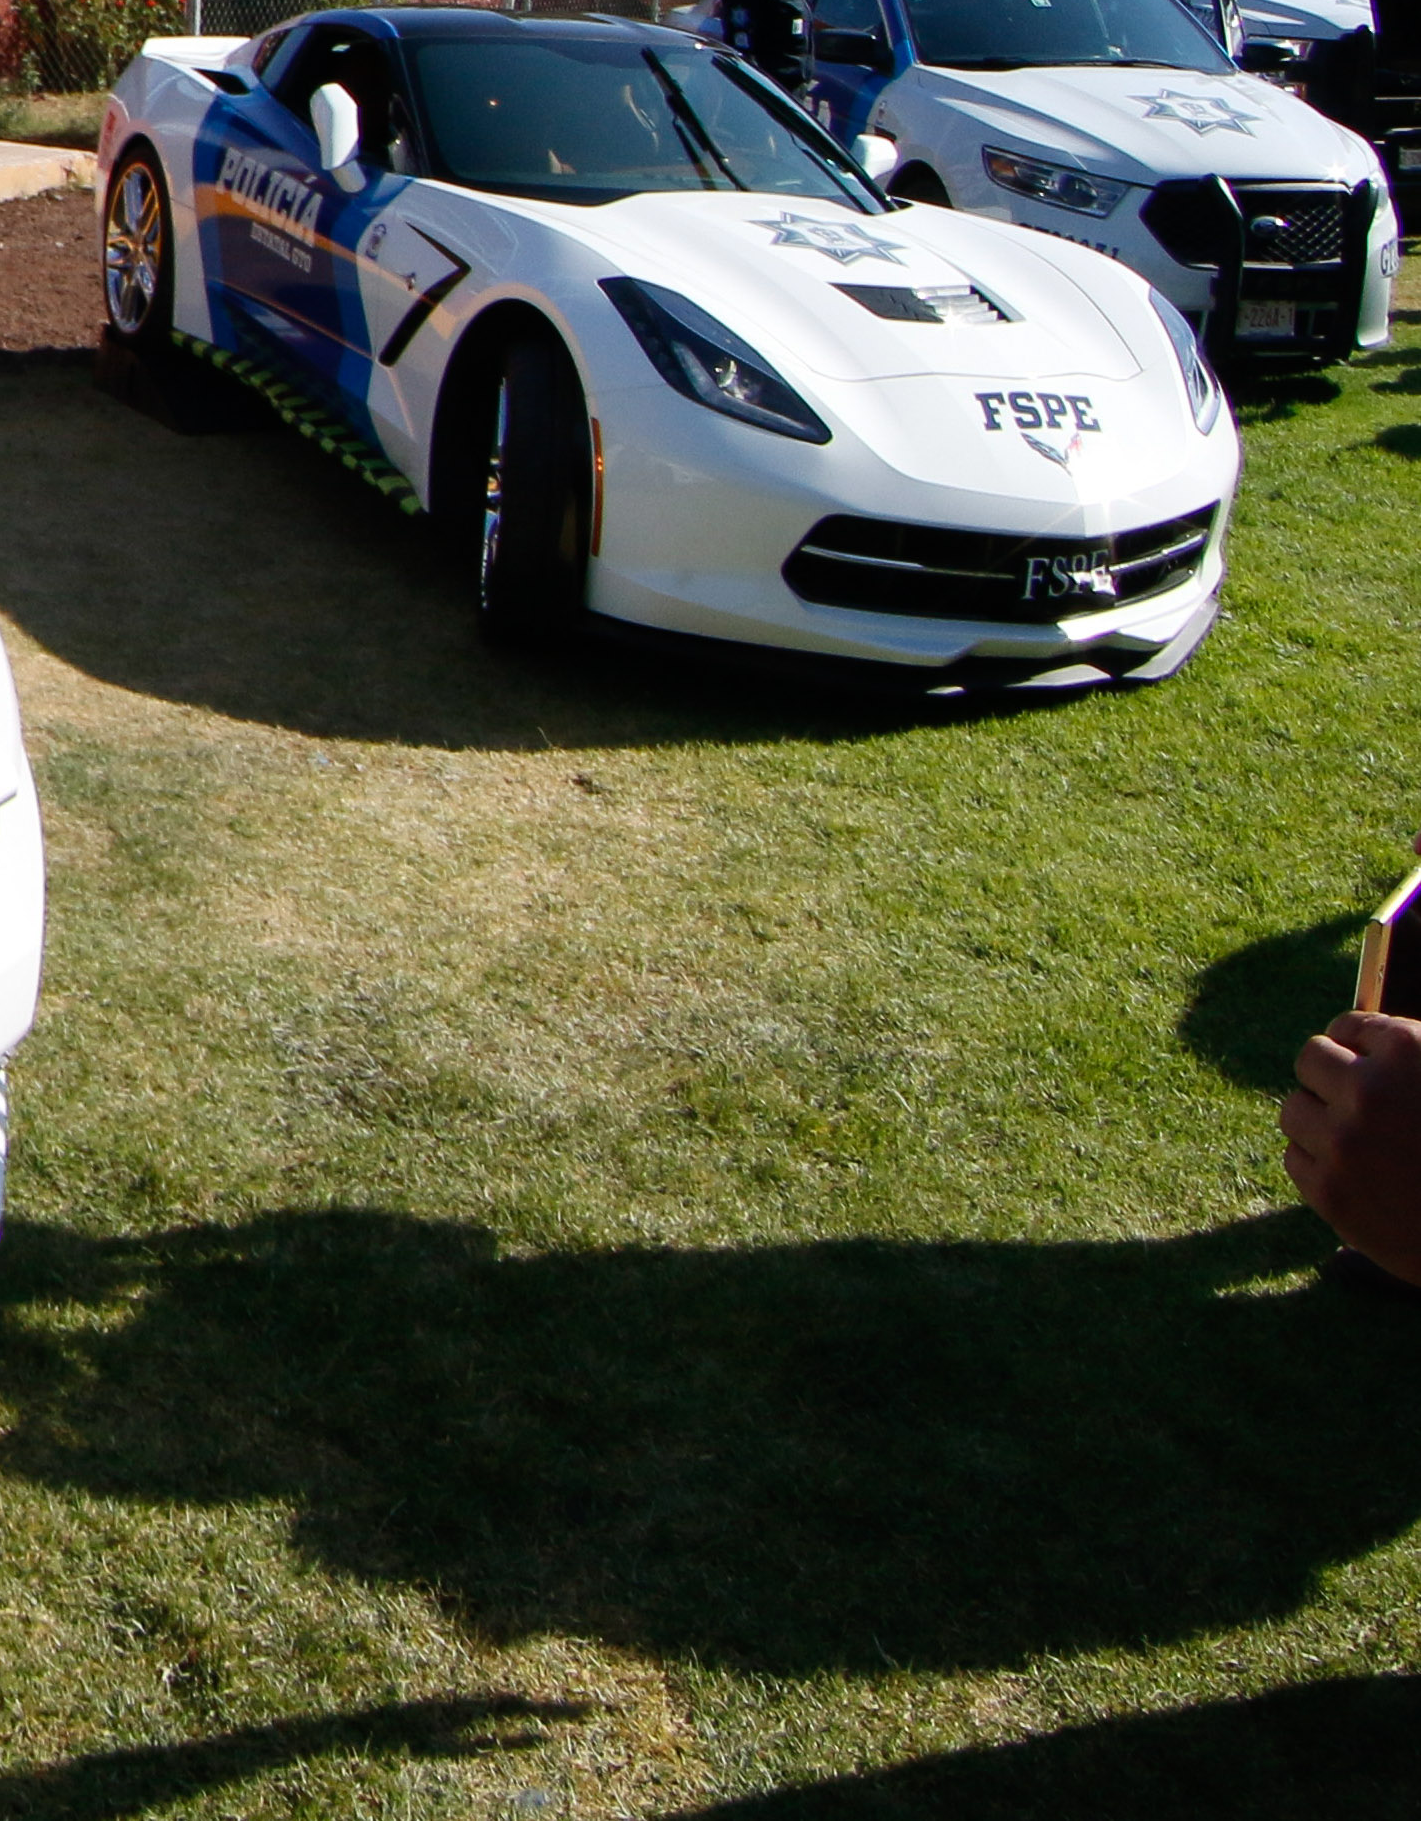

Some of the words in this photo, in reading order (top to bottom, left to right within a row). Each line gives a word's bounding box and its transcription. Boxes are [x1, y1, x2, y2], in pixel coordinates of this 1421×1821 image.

[216, 147, 324, 248] POLICÍA
[974, 391, 1102, 432] FSPE
[1020, 549, 1116, 600] FSPE
